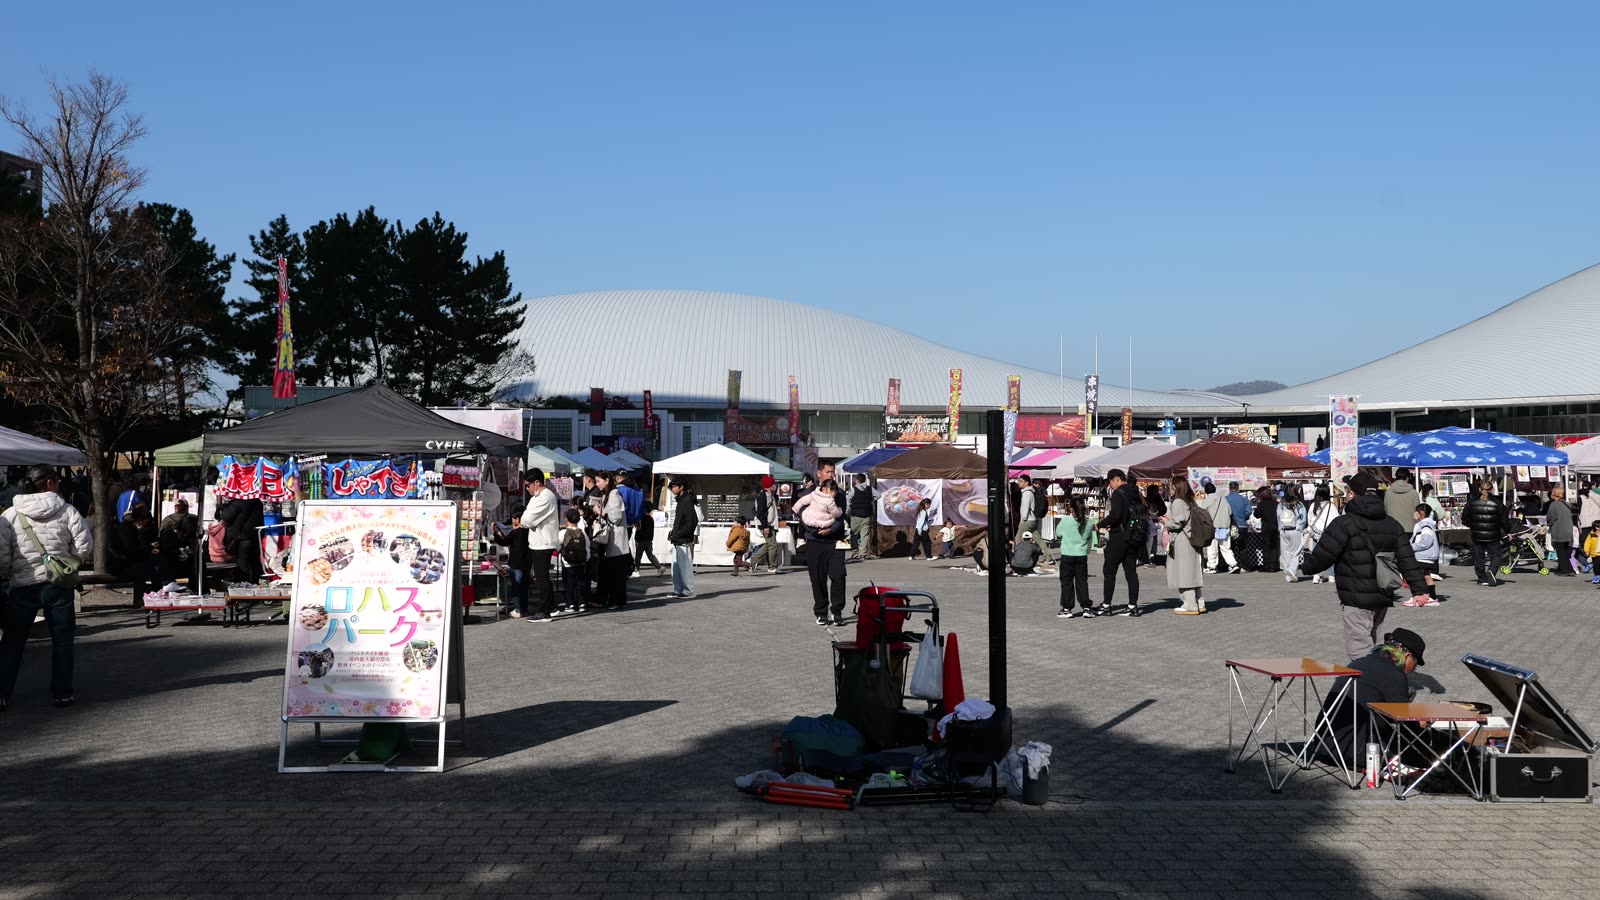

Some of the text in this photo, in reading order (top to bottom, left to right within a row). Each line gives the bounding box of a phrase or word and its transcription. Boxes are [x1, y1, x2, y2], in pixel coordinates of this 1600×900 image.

[1086, 376, 1097, 412] 串焼き
[887, 424, 949, 433] からあげ専門店
[332, 466, 410, 497] しゃてき
[324, 586, 423, 614] ロハス
[321, 614, 418, 648] パーク
